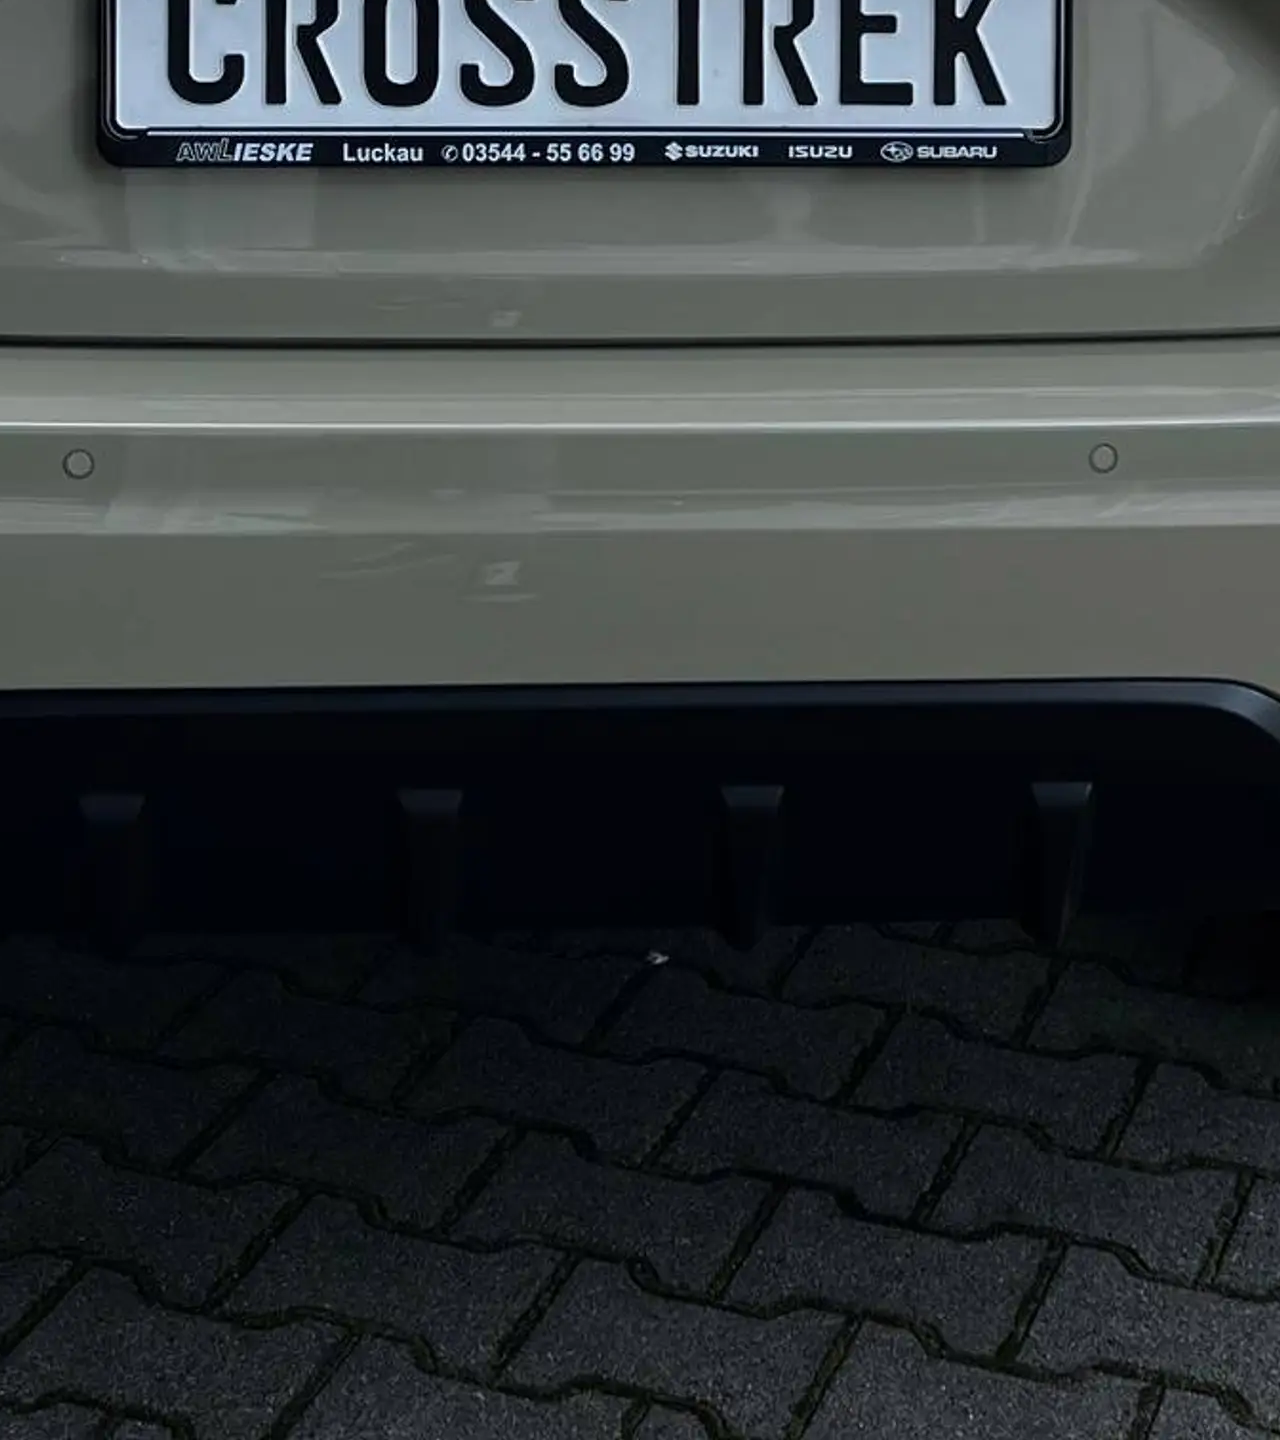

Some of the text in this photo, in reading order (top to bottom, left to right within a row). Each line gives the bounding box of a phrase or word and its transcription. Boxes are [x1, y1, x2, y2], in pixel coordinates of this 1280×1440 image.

[176, 138, 314, 162] AWLIESKE
[343, 143, 424, 162] Luckau
[462, 143, 526, 162] 03544
[546, 143, 571, 162] 55
[578, 143, 603, 162] 66
[610, 143, 635, 162] 99
[685, 145, 759, 159] SUZUKI
[788, 145, 853, 159] ISUZU
[917, 145, 998, 160] SUBARU
